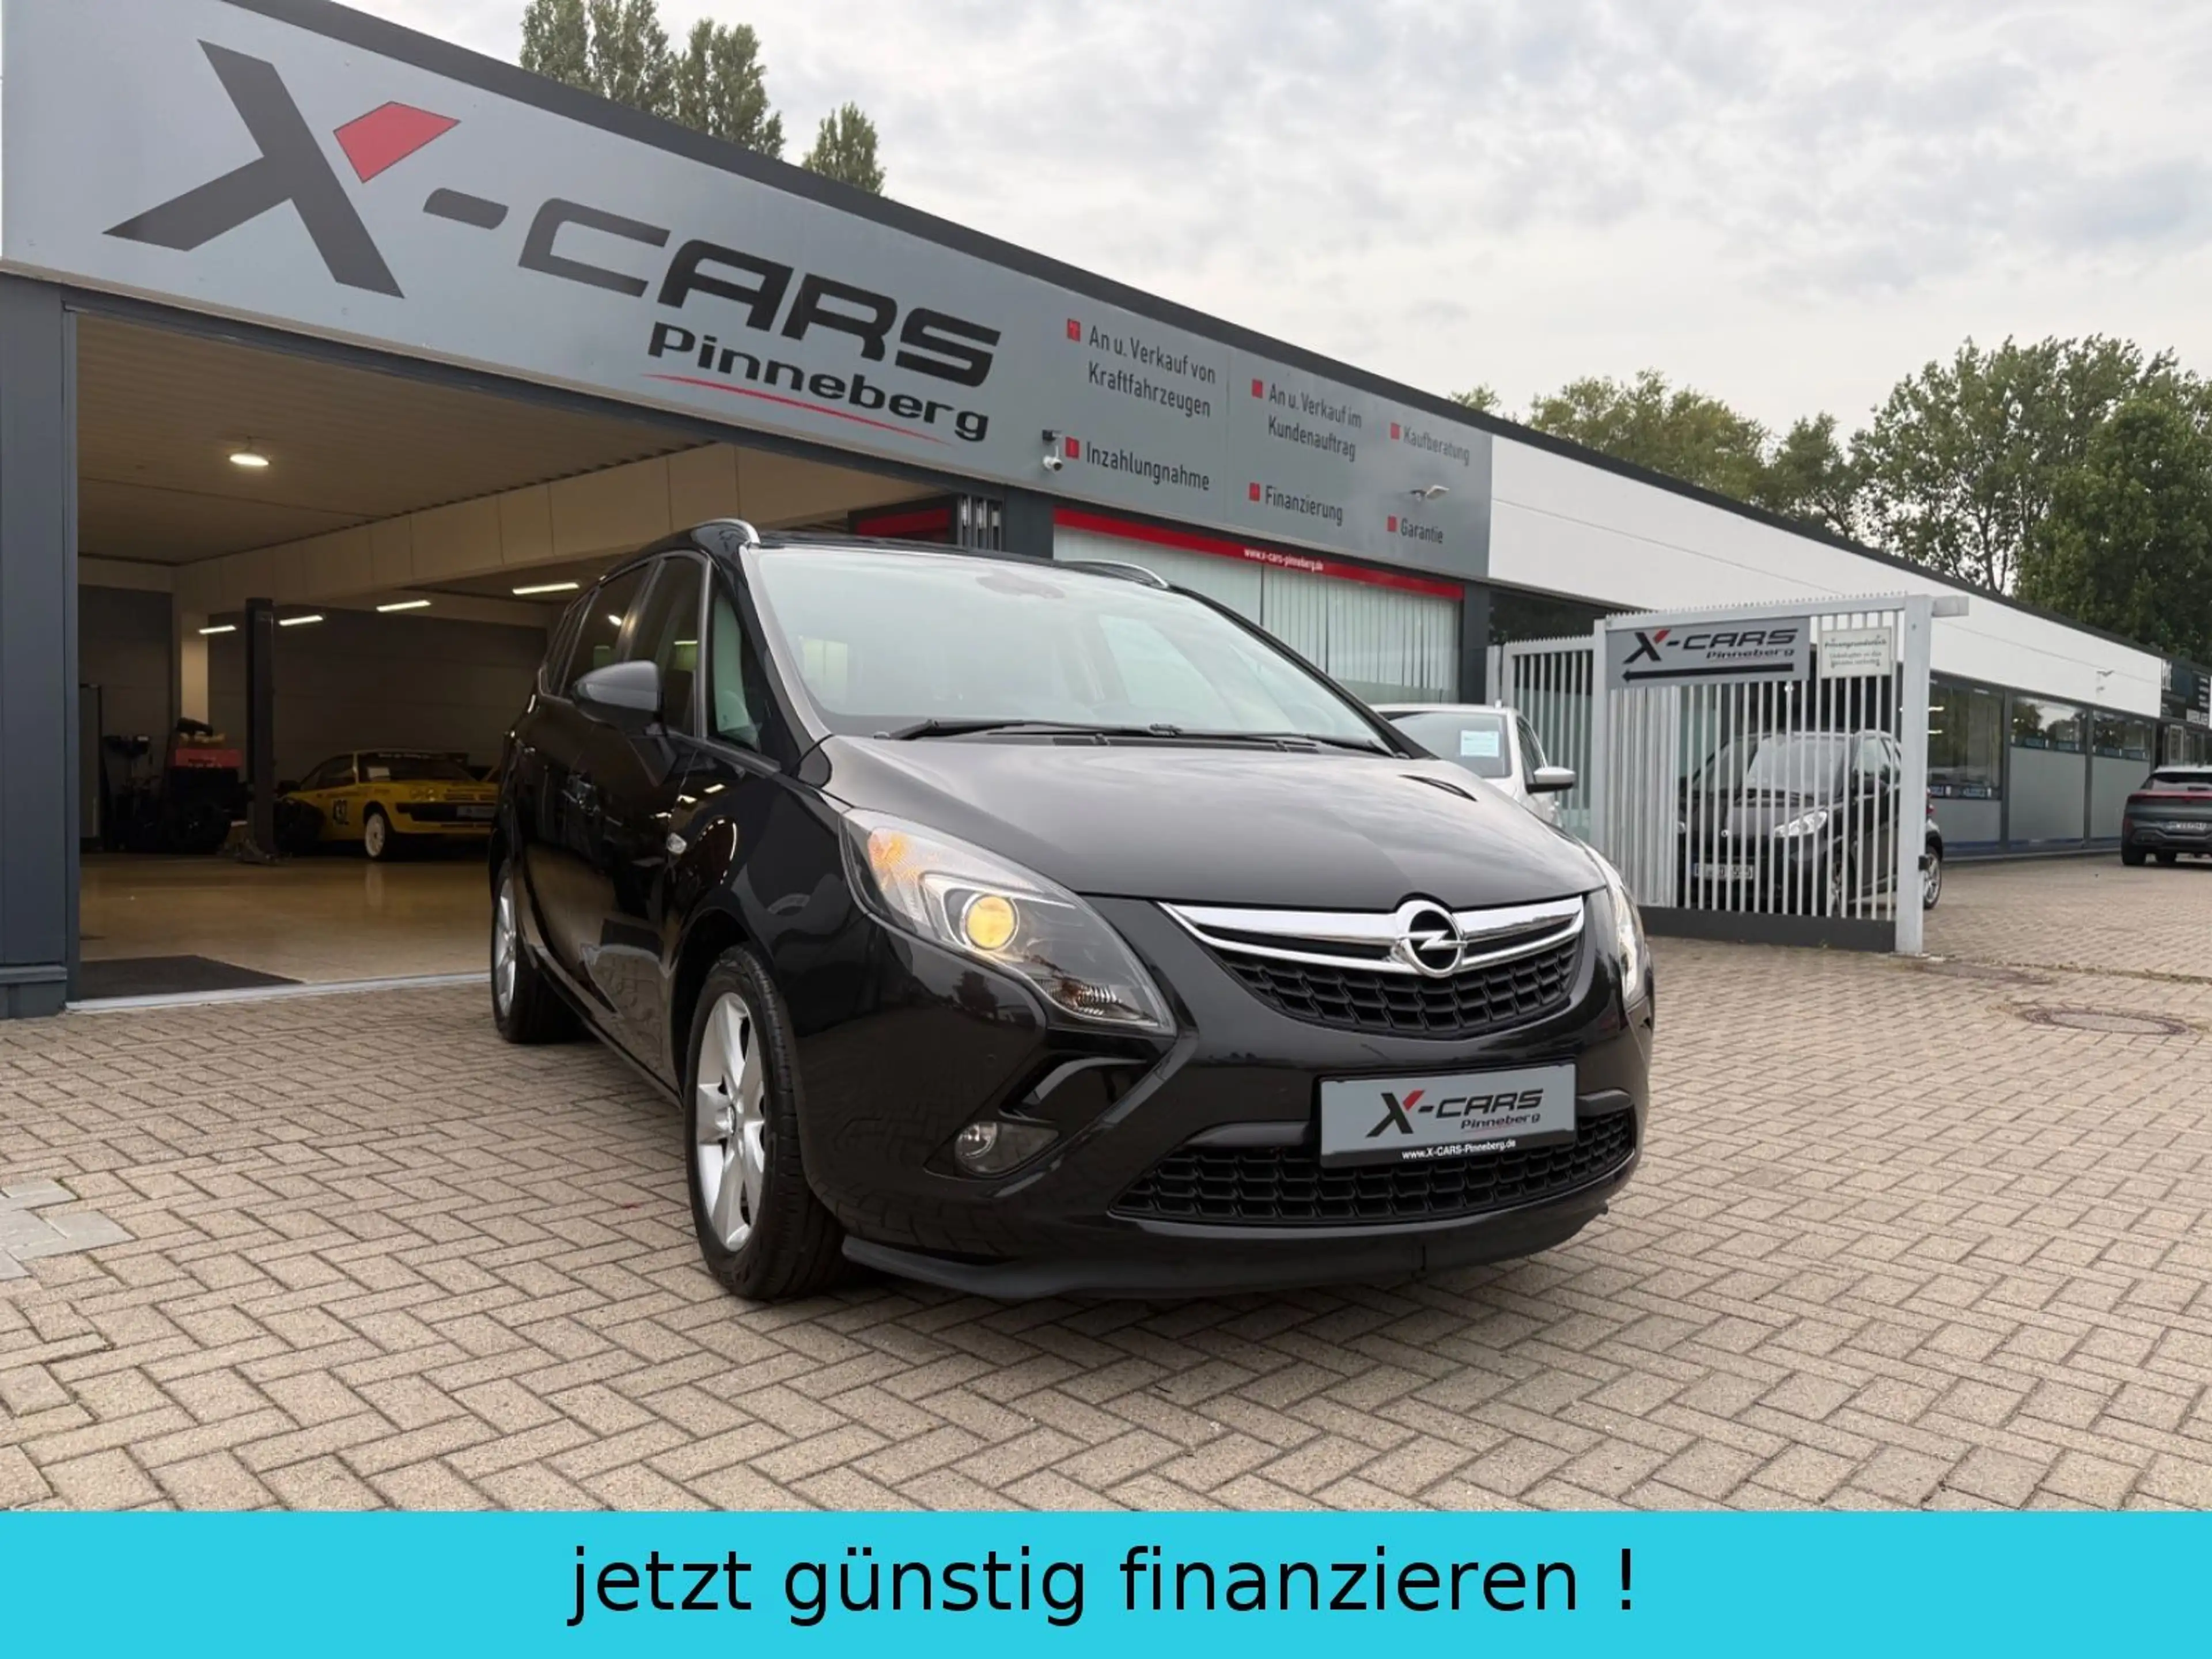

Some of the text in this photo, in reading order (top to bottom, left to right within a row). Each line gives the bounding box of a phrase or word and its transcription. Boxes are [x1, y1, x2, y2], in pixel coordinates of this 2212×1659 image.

[101, 39, 1001, 388] X-CARS
[1089, 325, 1215, 384] An u. Verkauf von
[647, 321, 989, 442] Pinneberg
[1088, 360, 1211, 418] Kraftfahrzeugen
[1269, 382, 1362, 429] An u. Verkauf im
[1268, 414, 1356, 463] Kundenauftrag
[1403, 425, 1470, 467] Kaufberatung
[1085, 440, 1210, 491] Inzahlungnahme
[1265, 484, 1343, 527] Finanzierung
[1400, 517, 1444, 544] Garantie
[1622, 628, 1800, 665] X-CARS
[1706, 647, 1795, 660] Pinneberg
[1365, 1088, 1544, 1139] X-CARS
[1460, 1112, 1541, 1130] Pinneberg
[1402, 1139, 1516, 1160] www.X-CARS-Pinneberg.de
